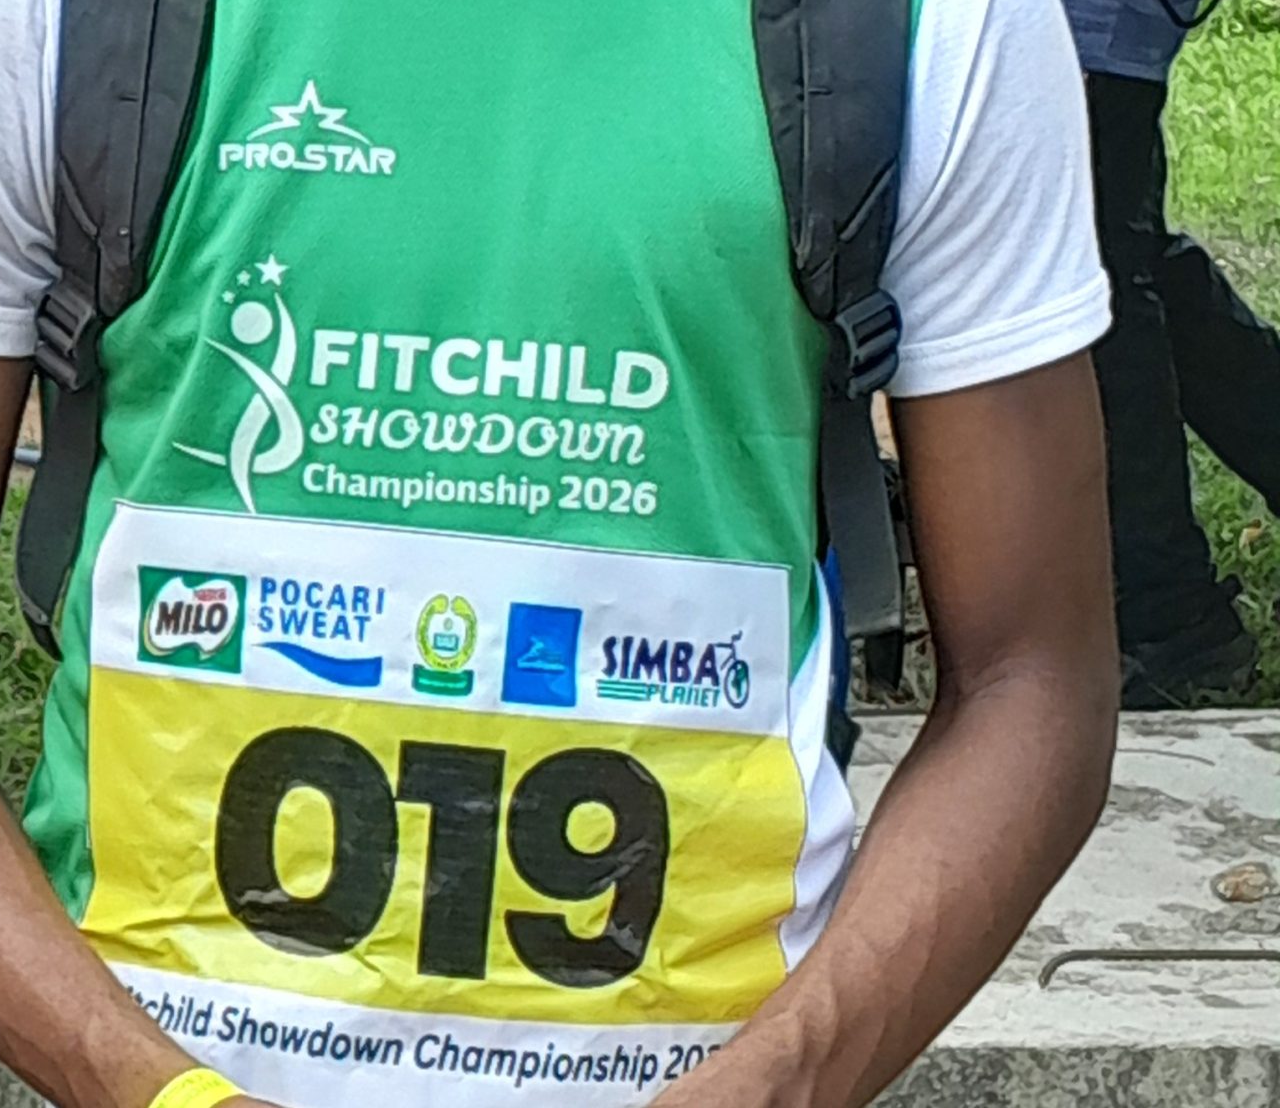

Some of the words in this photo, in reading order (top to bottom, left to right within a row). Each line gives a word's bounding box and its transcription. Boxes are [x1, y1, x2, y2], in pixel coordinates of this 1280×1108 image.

[309, 329, 669, 409] FITCHILD
[302, 463, 551, 514] Championship
[558, 475, 659, 515] 2026
[155, 601, 229, 635] MILO
[260, 576, 386, 615] POCARI
[257, 606, 372, 642] SWEAT
[601, 635, 721, 687] SIMBA
[214, 726, 671, 988] 019
[216, 1005, 405, 1066] Showdown
[413, 1033, 659, 1092] Championship
